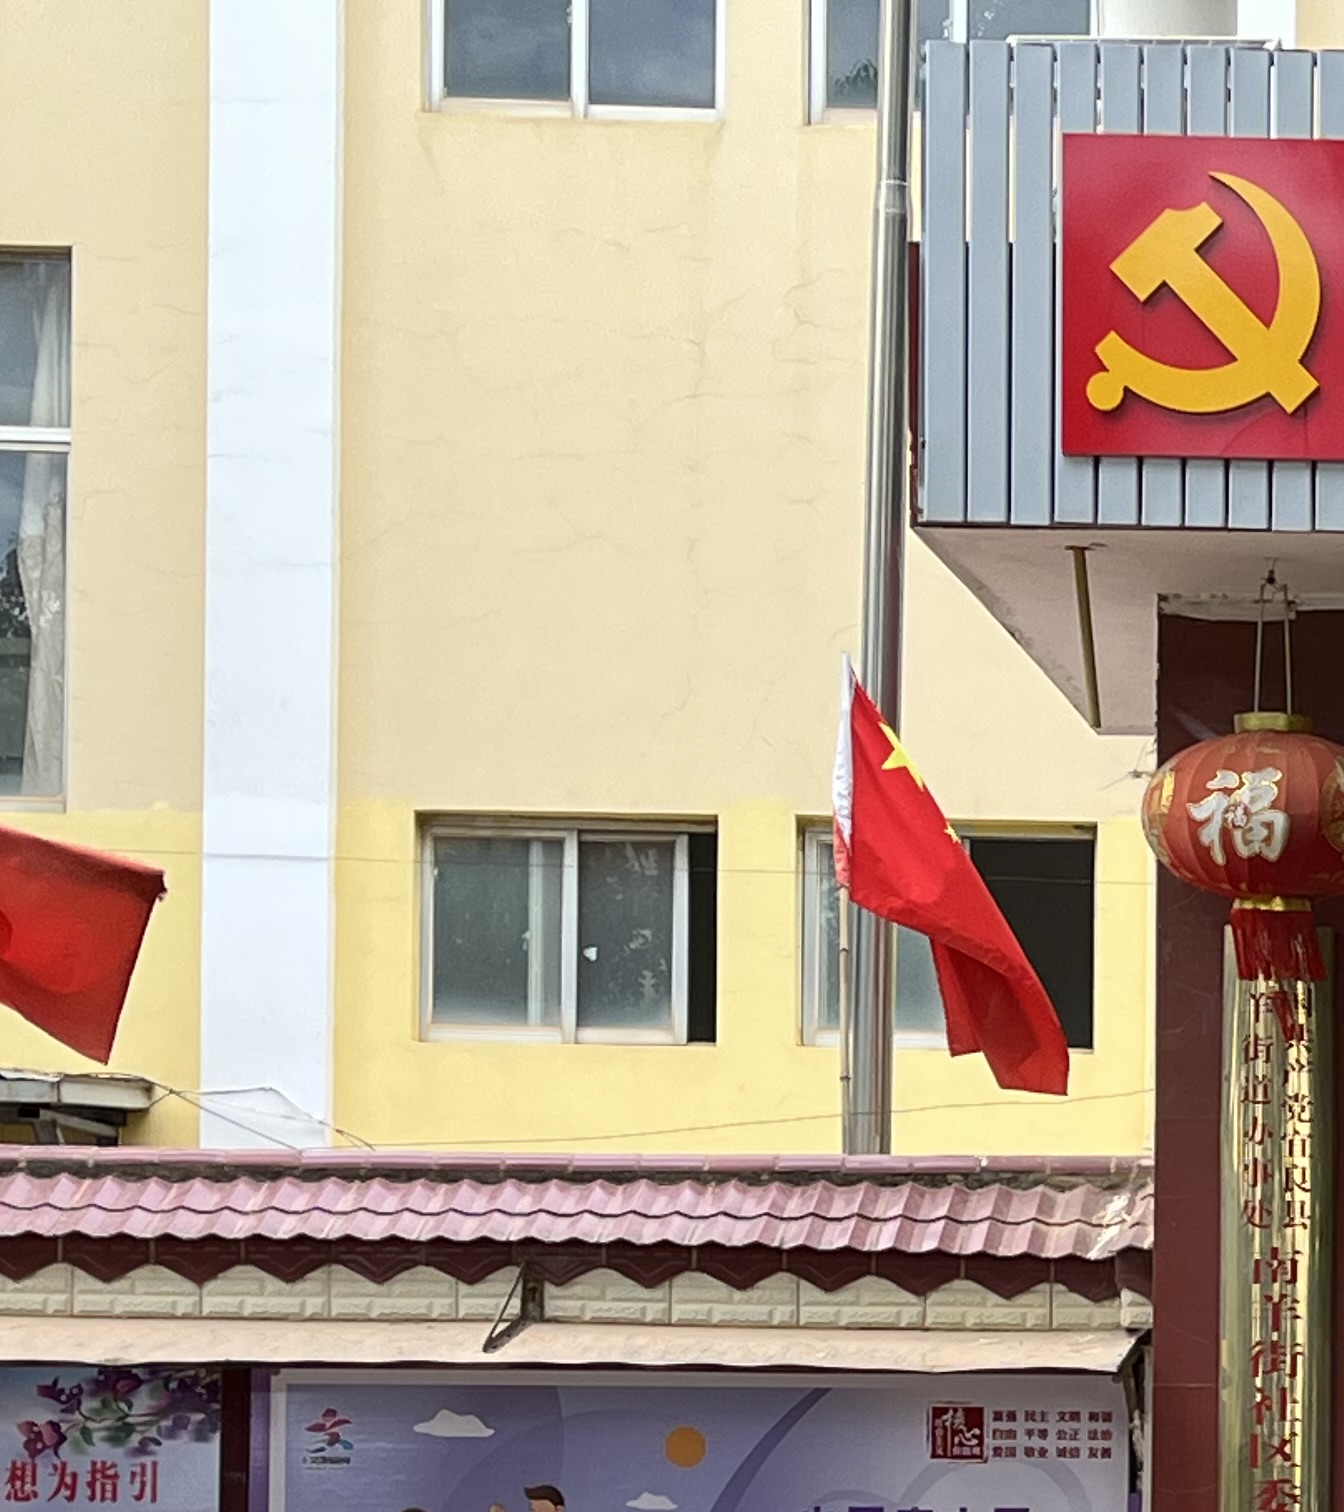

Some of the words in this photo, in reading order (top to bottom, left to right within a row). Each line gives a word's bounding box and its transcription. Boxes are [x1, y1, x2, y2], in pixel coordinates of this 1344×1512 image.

[1186, 767, 1291, 866] 福
[5, 1459, 160, 1504] 想为指引
